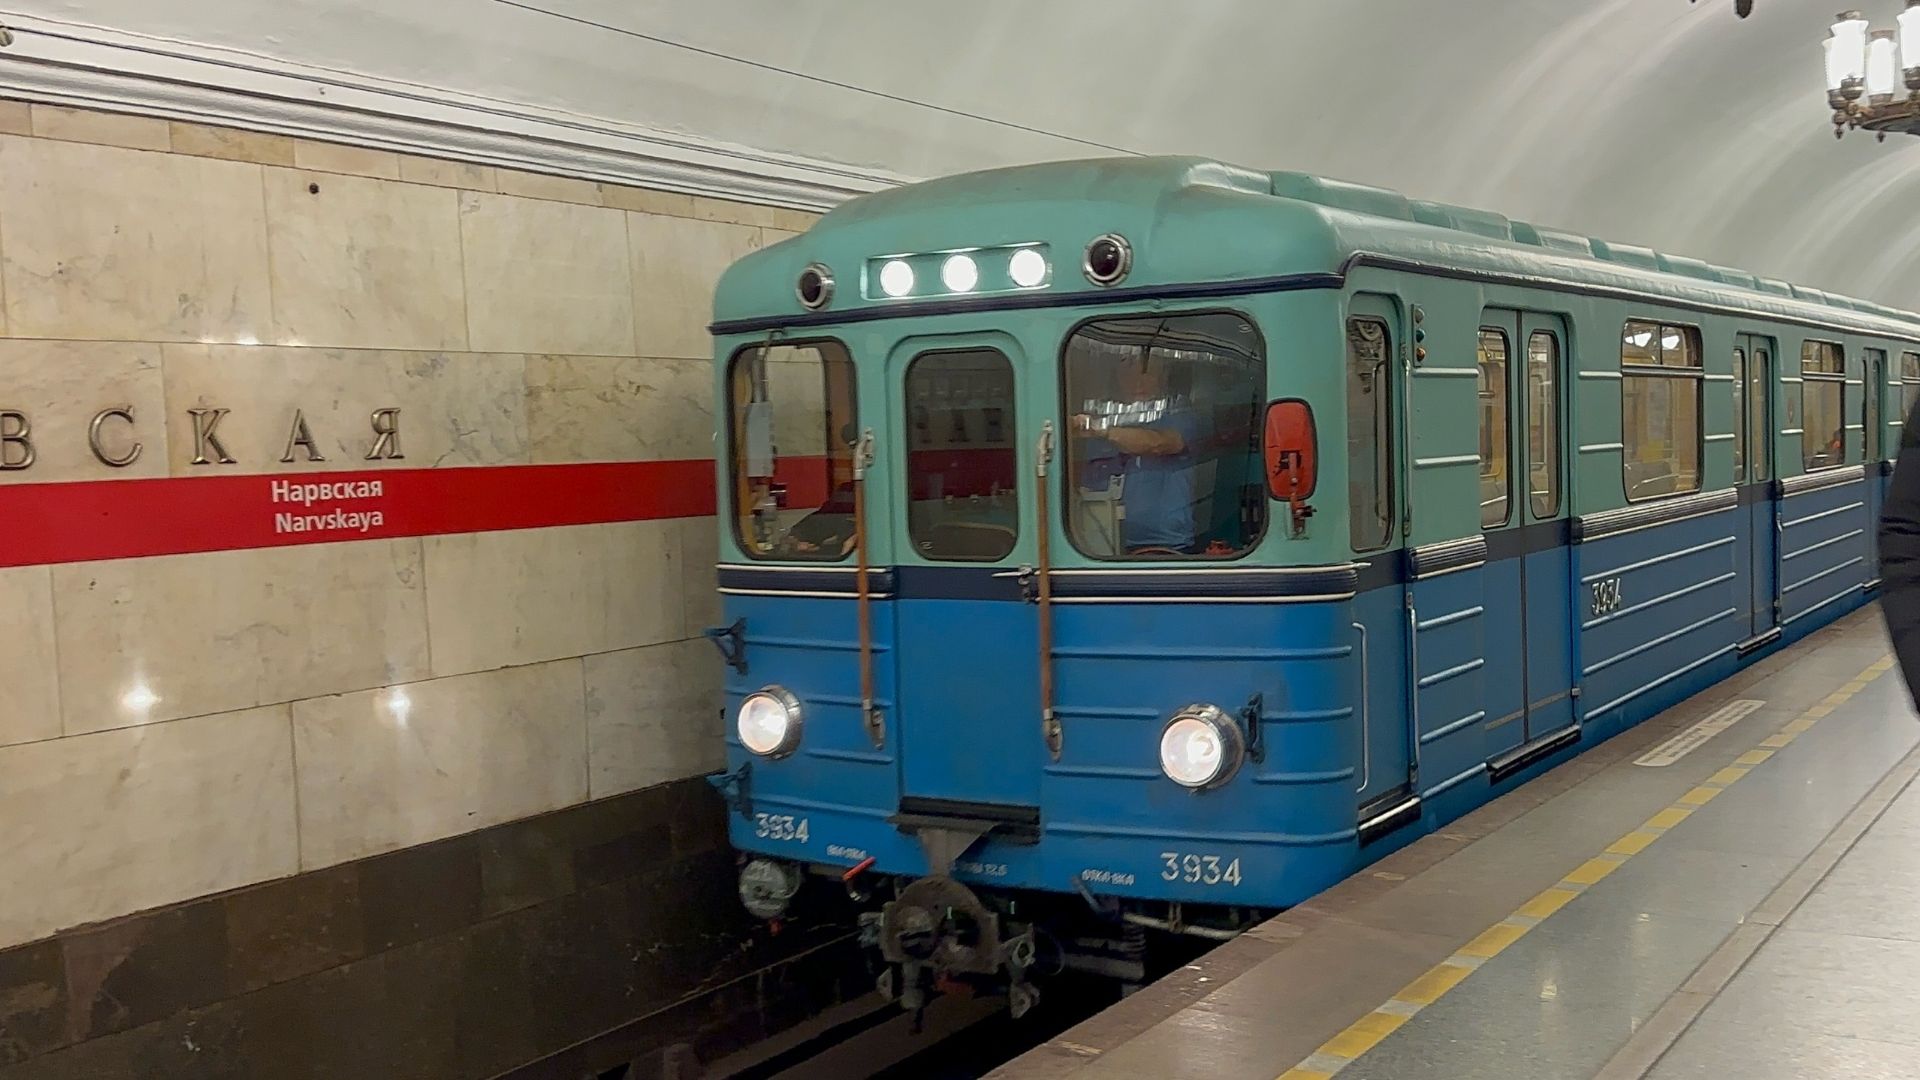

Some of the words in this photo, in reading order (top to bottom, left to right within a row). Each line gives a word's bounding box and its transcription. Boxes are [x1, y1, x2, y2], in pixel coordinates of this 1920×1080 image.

[271, 479, 384, 507] Нарвская
[274, 507, 384, 534] Narvskaya
[755, 812, 810, 844] 3934
[1160, 852, 1243, 887] 3934
